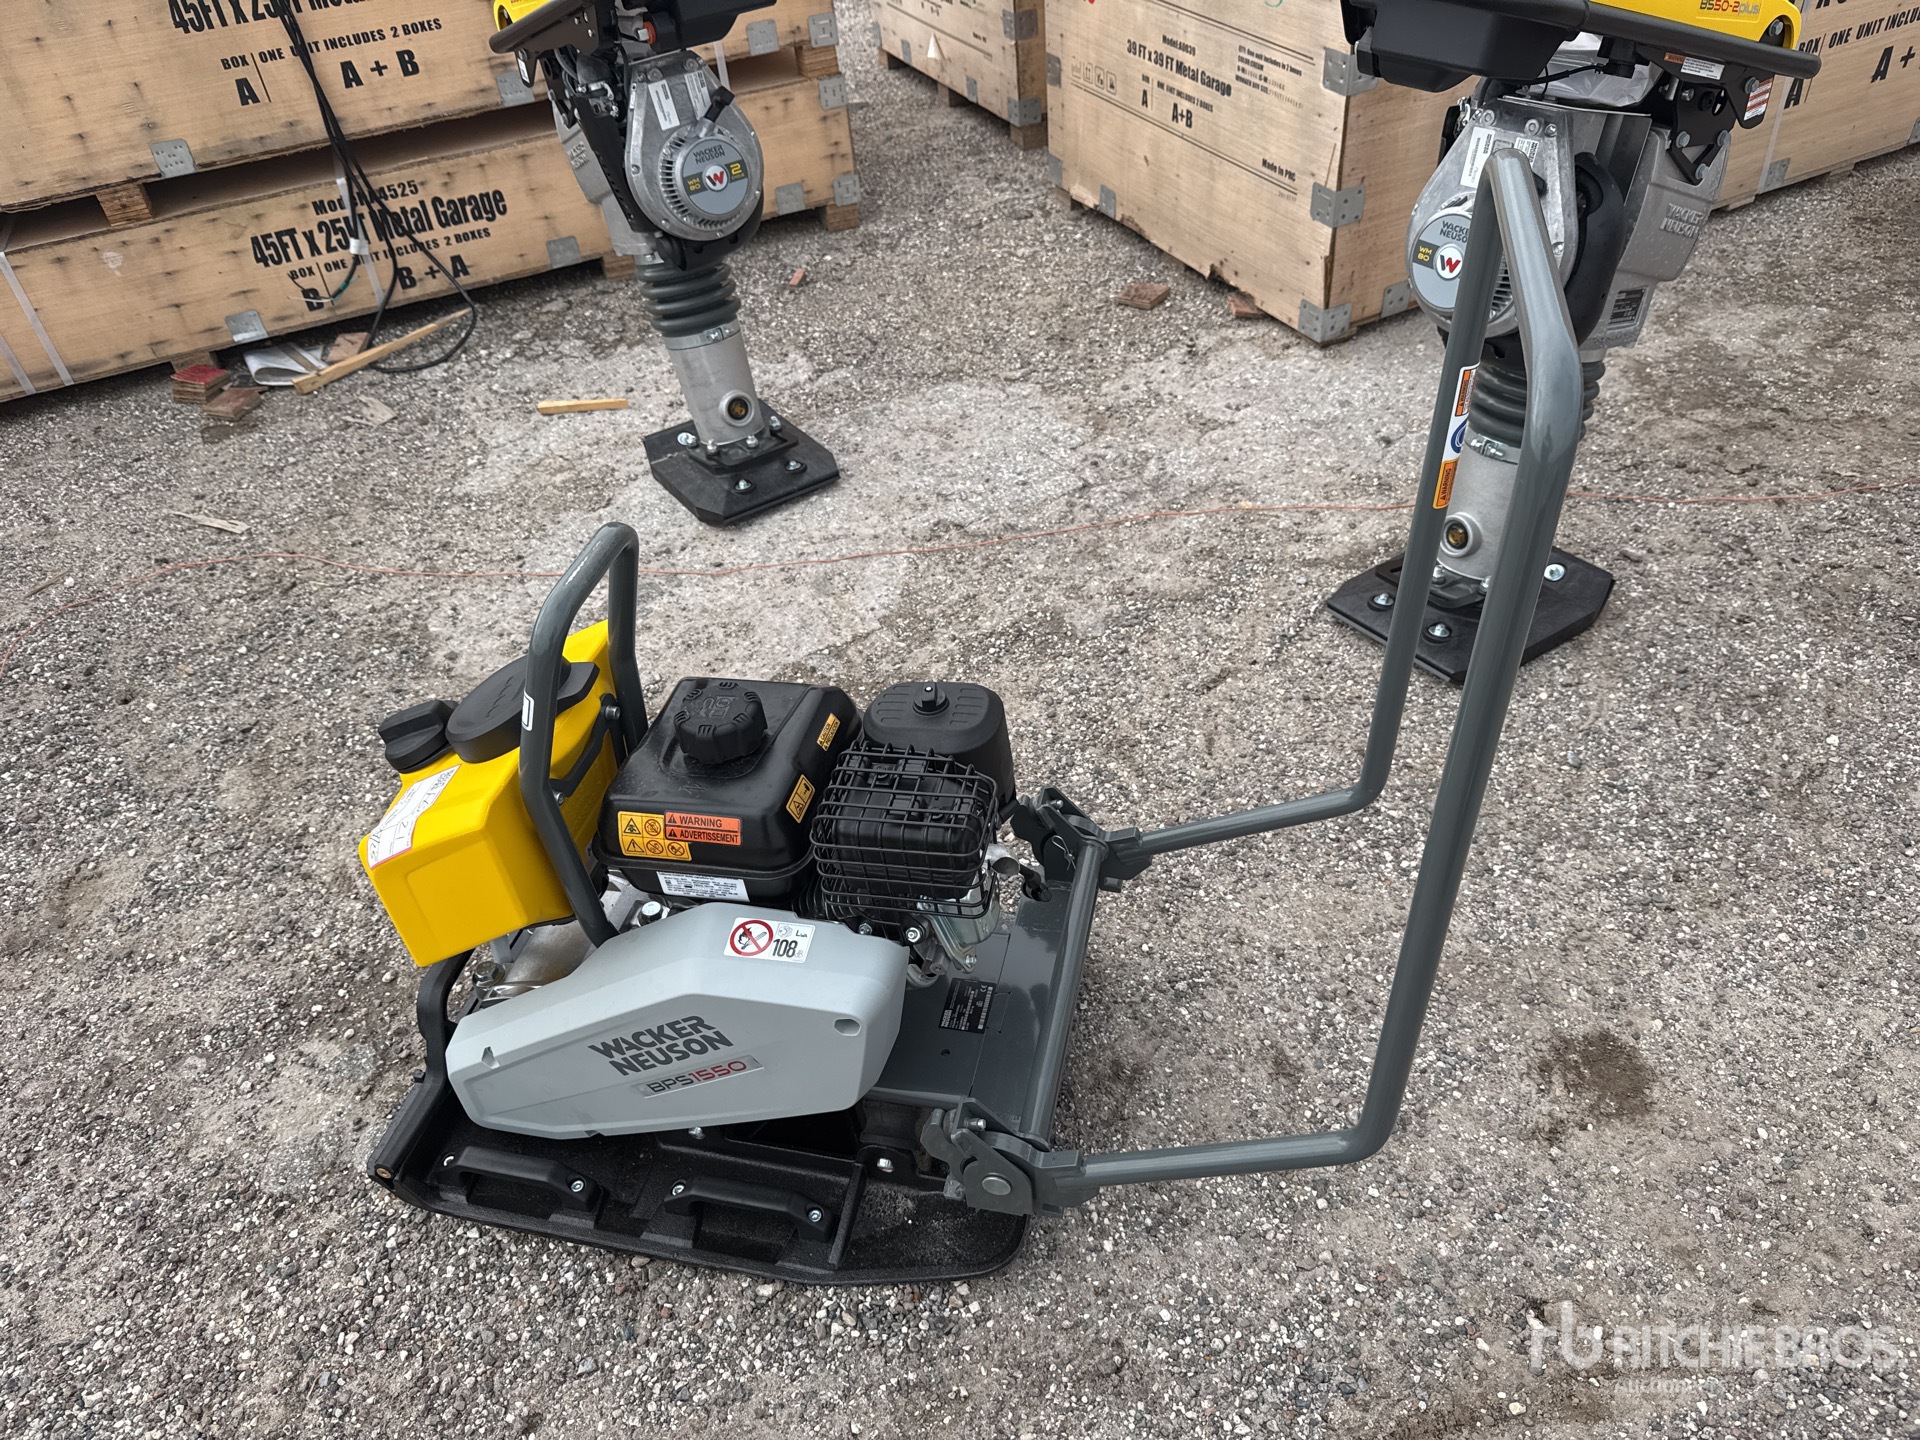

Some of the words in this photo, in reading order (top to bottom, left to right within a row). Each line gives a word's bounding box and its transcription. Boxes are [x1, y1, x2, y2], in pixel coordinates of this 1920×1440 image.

[258, 47, 286, 64] ONE
[289, 40, 321, 57] UIT
[323, 28, 387, 51] INCLUDES
[390, 26, 400, 39] 2
[402, 18, 443, 37] BOXES
[1828, 27, 1853, 48] ONE
[1856, 17, 1885, 40] UNIT
[220, 54, 250, 70] BOX
[340, 60, 364, 89] A
[396, 49, 420, 77] B
[1126, 39, 1138, 55] 39
[1138, 44, 1148, 60] FT
[1153, 52, 1165, 69] 39
[1165, 56, 1175, 72] FT
[1175, 61, 1199, 83] Metal
[1871, 45, 1894, 83] A
[235, 77, 261, 107] A
[1141, 89, 1149, 108] A
[693, 144, 723, 158] WACKER
[695, 149, 725, 165] NEUSON
[730, 163, 742, 175] 2
[1262, 158, 1277, 173] Made
[250, 227, 304, 268] 45FT
[368, 199, 434, 243] Metal
[431, 189, 508, 229] Garage
[1439, 228, 1468, 244] NEUSO
[1442, 220, 1469, 236] WACKE
[324, 258, 348, 273] ONE
[444, 236, 452, 246] 2
[454, 227, 491, 244] BOXES
[1417, 253, 1430, 262] 80
[1419, 246, 1433, 255] WM
[288, 265, 315, 280] BOX
[398, 266, 417, 290] B
[450, 254, 470, 279] A
[1442, 468, 1452, 494] WARNING
[680, 815, 723, 828] WARNING
[680, 830, 739, 843] ADVERTISSEMENT
[772, 939, 798, 958] 108
[587, 1015, 716, 1059] WACKER
[608, 1030, 734, 1076] NEUSON
[647, 1060, 747, 1093] BPS1550
